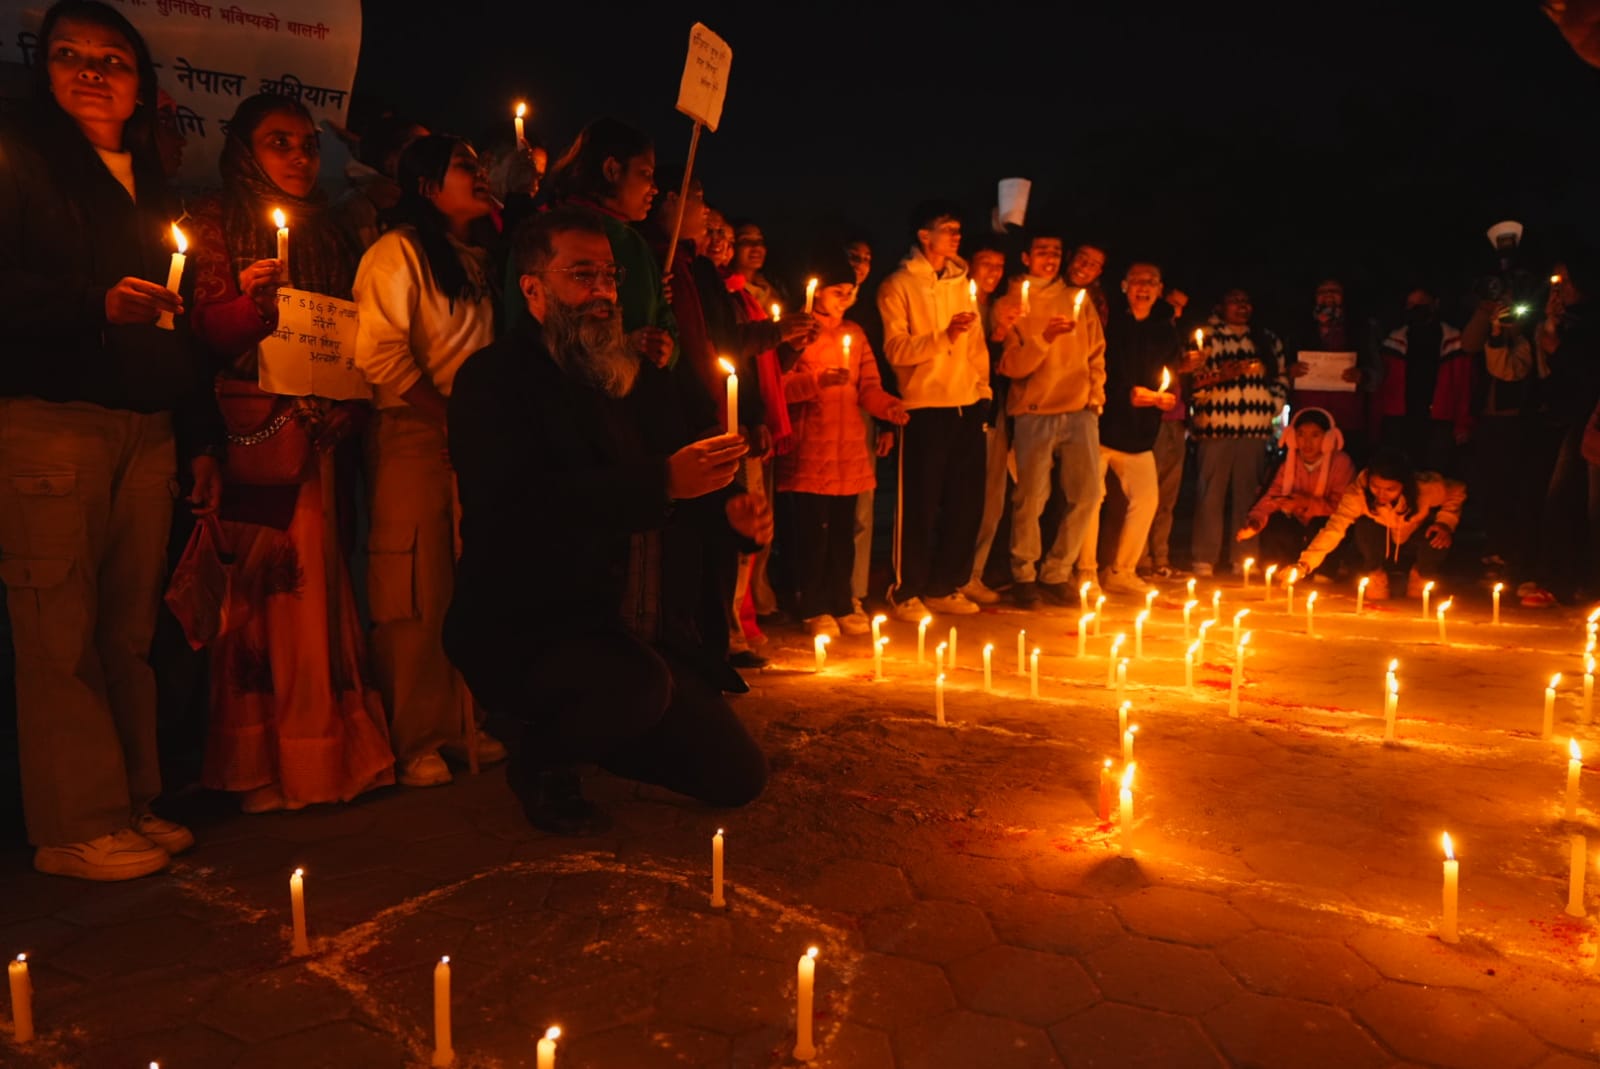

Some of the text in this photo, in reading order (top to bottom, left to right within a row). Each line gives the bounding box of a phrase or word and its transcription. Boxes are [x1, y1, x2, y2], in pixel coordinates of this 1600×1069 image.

[219, 6, 280, 32] भविष्यको
[173, 57, 347, 110] नेपाल अभियान
